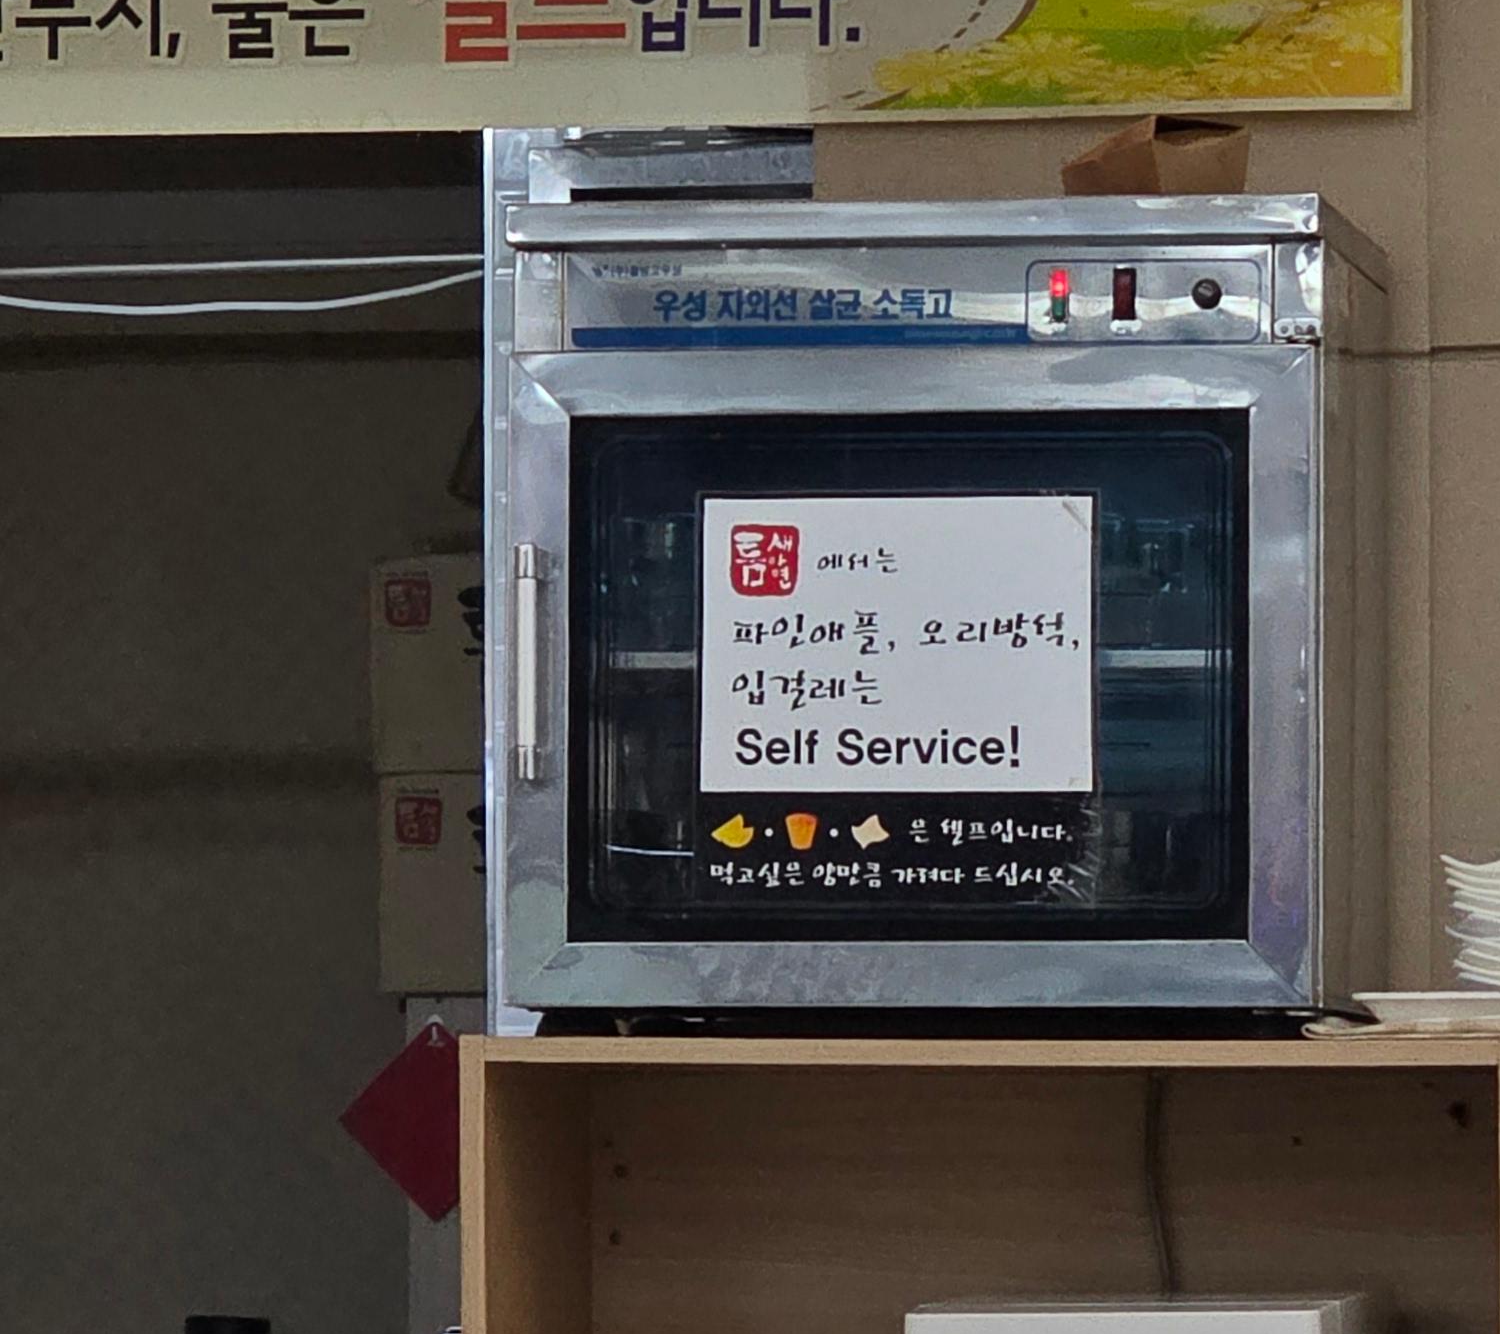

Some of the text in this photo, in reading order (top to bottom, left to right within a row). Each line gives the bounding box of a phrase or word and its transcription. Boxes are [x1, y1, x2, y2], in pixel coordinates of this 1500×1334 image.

[652, 288, 953, 323] 우성 자외선 살균 소독고
[816, 546, 899, 575] 에서는
[732, 610, 1080, 656] 파인애플, 오리방석,
[730, 669, 884, 712] 입걸레는
[734, 724, 1021, 769] Self Service!
[908, 818, 1074, 847] 은 셀프입니다.
[709, 861, 1075, 889] 먹고싶은 양만큼 가져다 드십시오.
